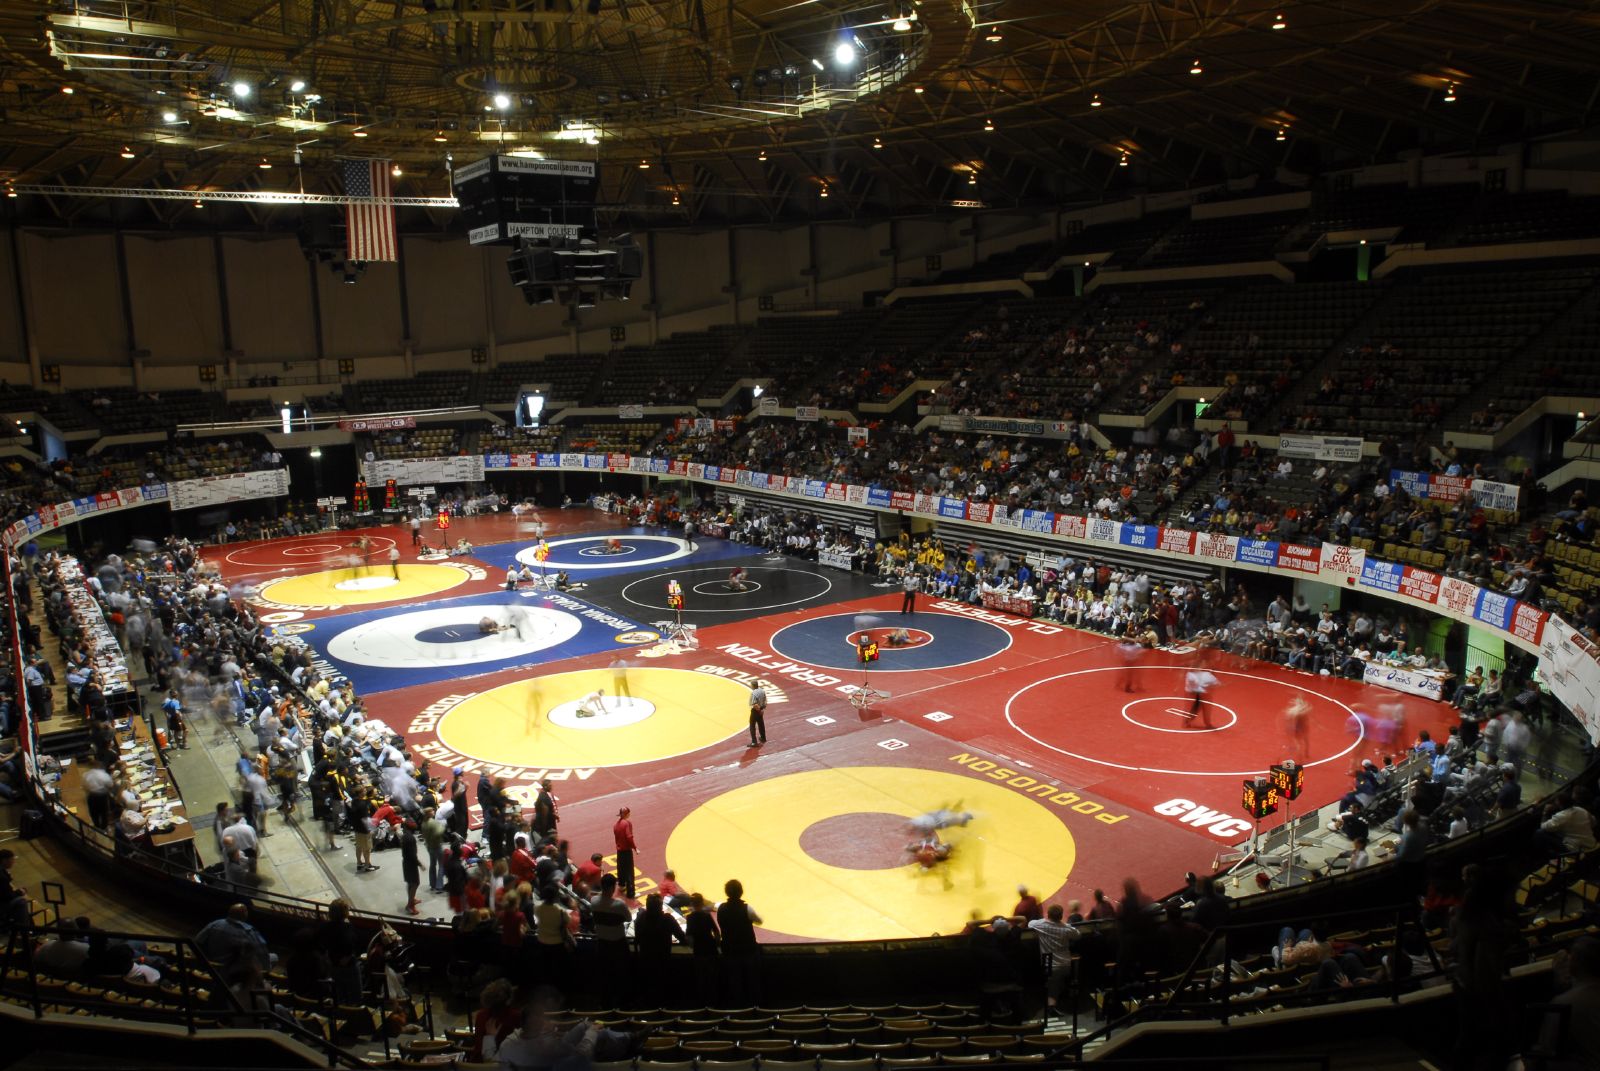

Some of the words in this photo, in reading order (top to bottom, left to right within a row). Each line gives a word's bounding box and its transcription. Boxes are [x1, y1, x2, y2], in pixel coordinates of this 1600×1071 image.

[510, 226, 544, 235] HAMPTON
[548, 228, 577, 236] COLISEU
[1332, 554, 1352, 565] COX
[1337, 546, 1350, 556] COX
[929, 600, 1063, 635] CLIPPERS
[717, 642, 842, 687] GRAFTON
[407, 692, 477, 734] SCHOOL
[412, 740, 598, 781] APPRENTICE
[948, 753, 1130, 826] POQUOSON
[1153, 797, 1253, 838] GWC
